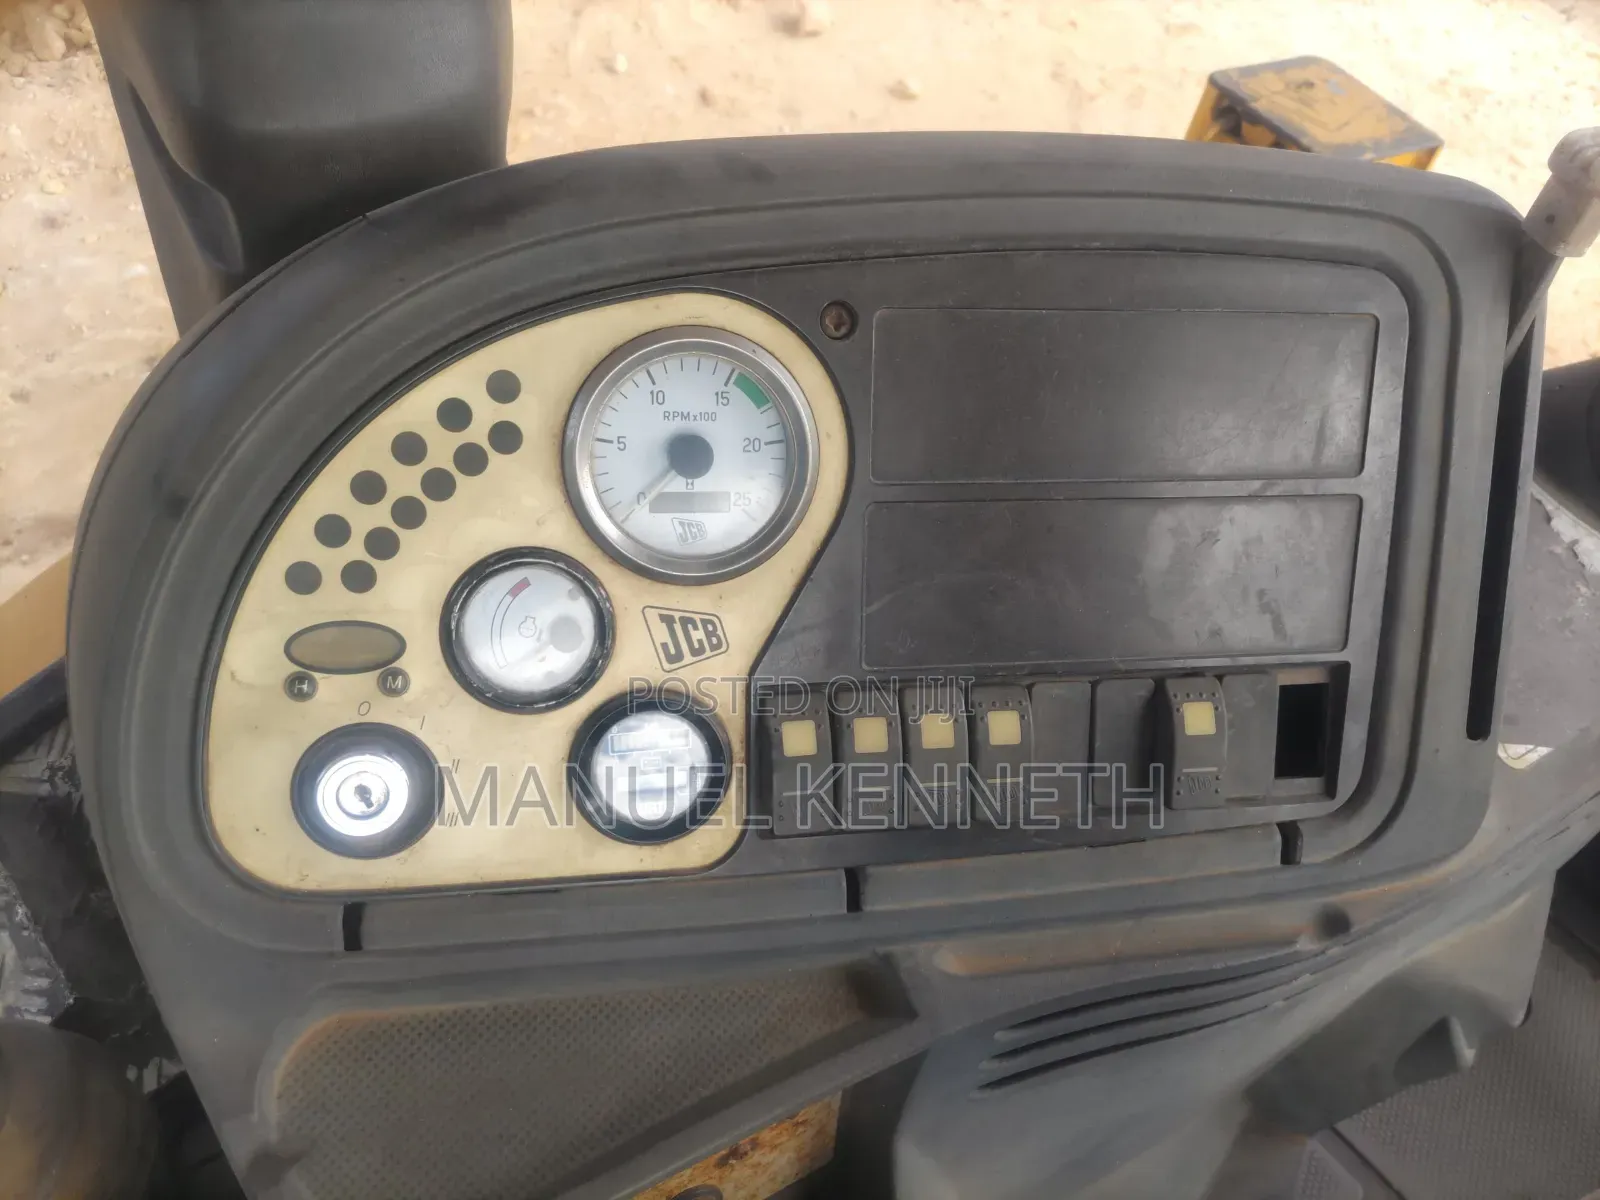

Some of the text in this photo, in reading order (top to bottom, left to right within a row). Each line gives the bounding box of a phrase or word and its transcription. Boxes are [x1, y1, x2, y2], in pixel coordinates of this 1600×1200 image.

[649, 390, 666, 406] 10
[714, 391, 731, 407] 15
[616, 436, 627, 452] 5
[742, 437, 761, 453] 20
[732, 492, 752, 507] 25
[678, 520, 706, 543] JCB
[658, 612, 724, 666] JCB
[294, 679, 309, 694] H
[386, 675, 403, 690] M
